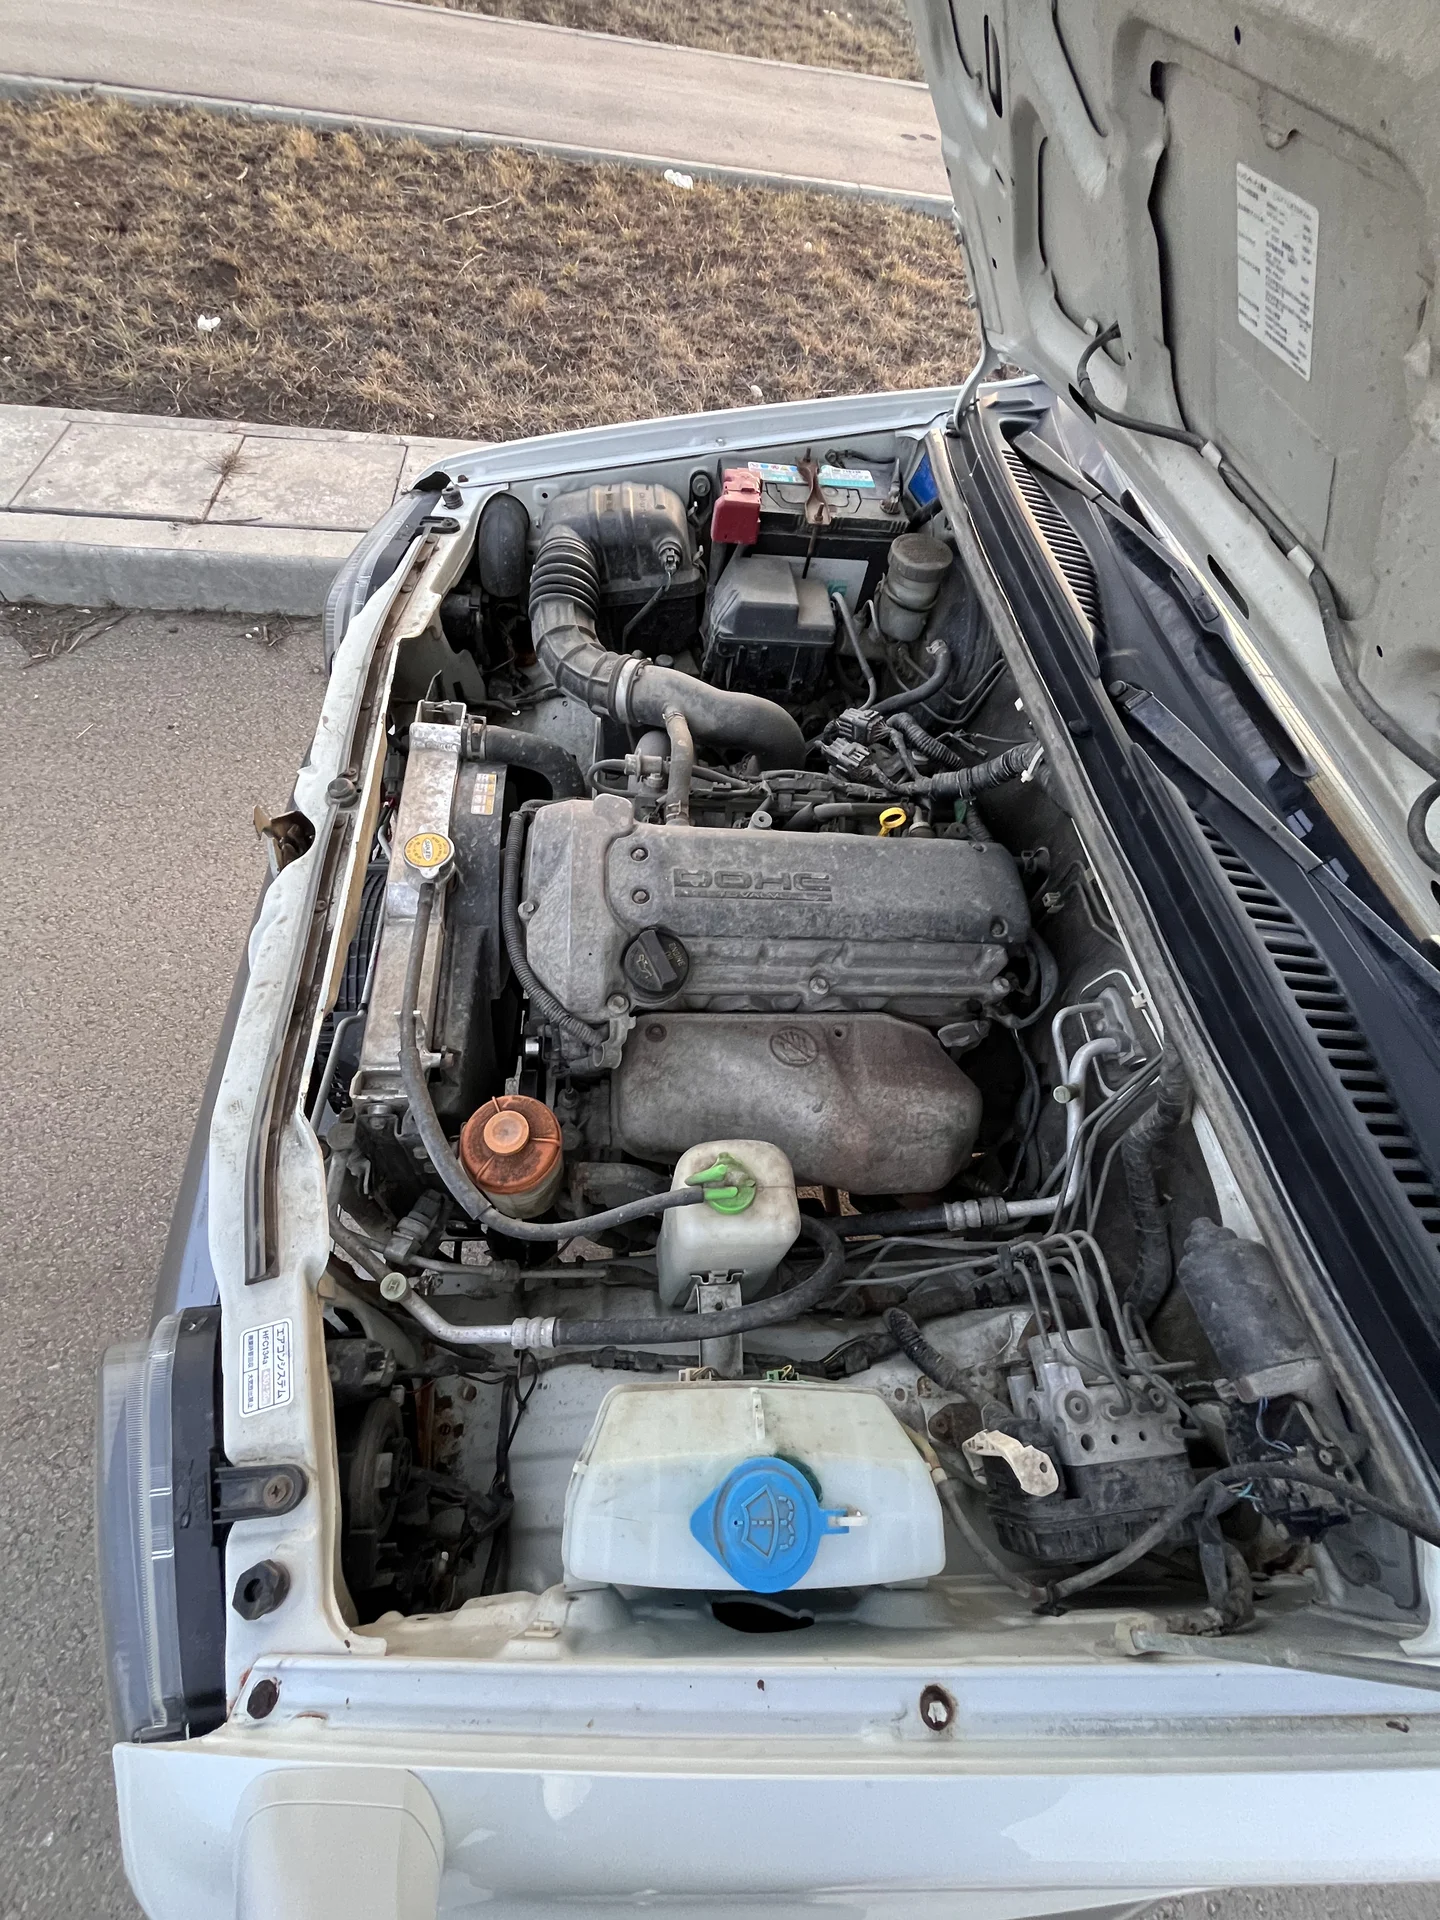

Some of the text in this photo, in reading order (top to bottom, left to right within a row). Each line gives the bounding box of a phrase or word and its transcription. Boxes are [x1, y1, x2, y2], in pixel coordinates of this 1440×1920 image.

[673, 869, 832, 892] DOHC
[668, 942, 686, 967] ENGINE
[387, 1279, 400, 1290] H
[262, 1330, 270, 1365] HFC134a
[277, 1328, 286, 1399] エアコンシステム
